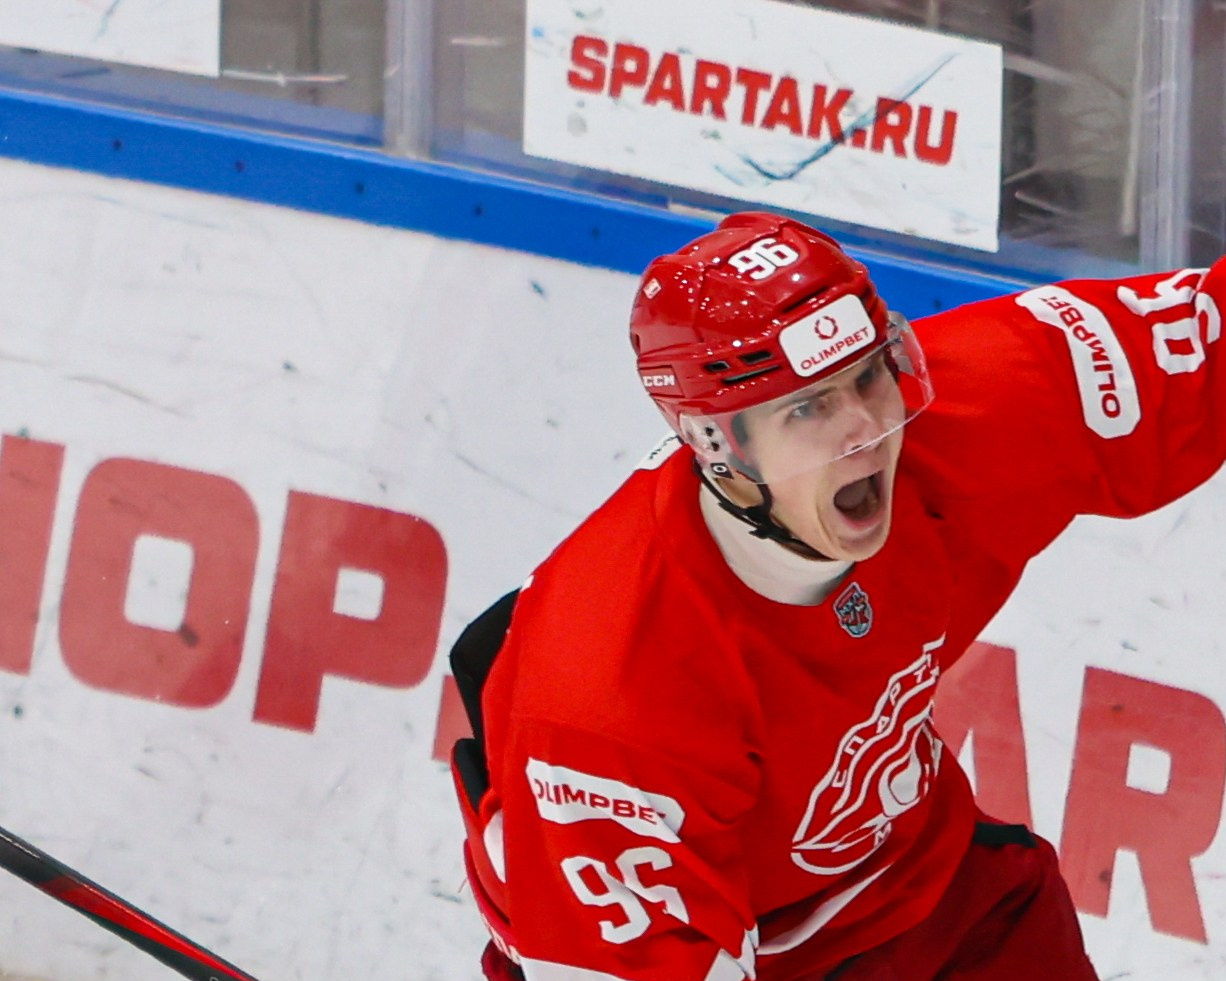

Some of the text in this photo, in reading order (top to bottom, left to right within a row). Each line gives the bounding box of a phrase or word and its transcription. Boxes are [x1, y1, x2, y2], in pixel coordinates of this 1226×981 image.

[567, 35, 957, 165] SPARTAK.RU
[728, 238, 799, 280] 96
[800, 327, 869, 370] OLIMPBET
[643, 374, 675, 387] CCM
[560, 846, 690, 944] 96
